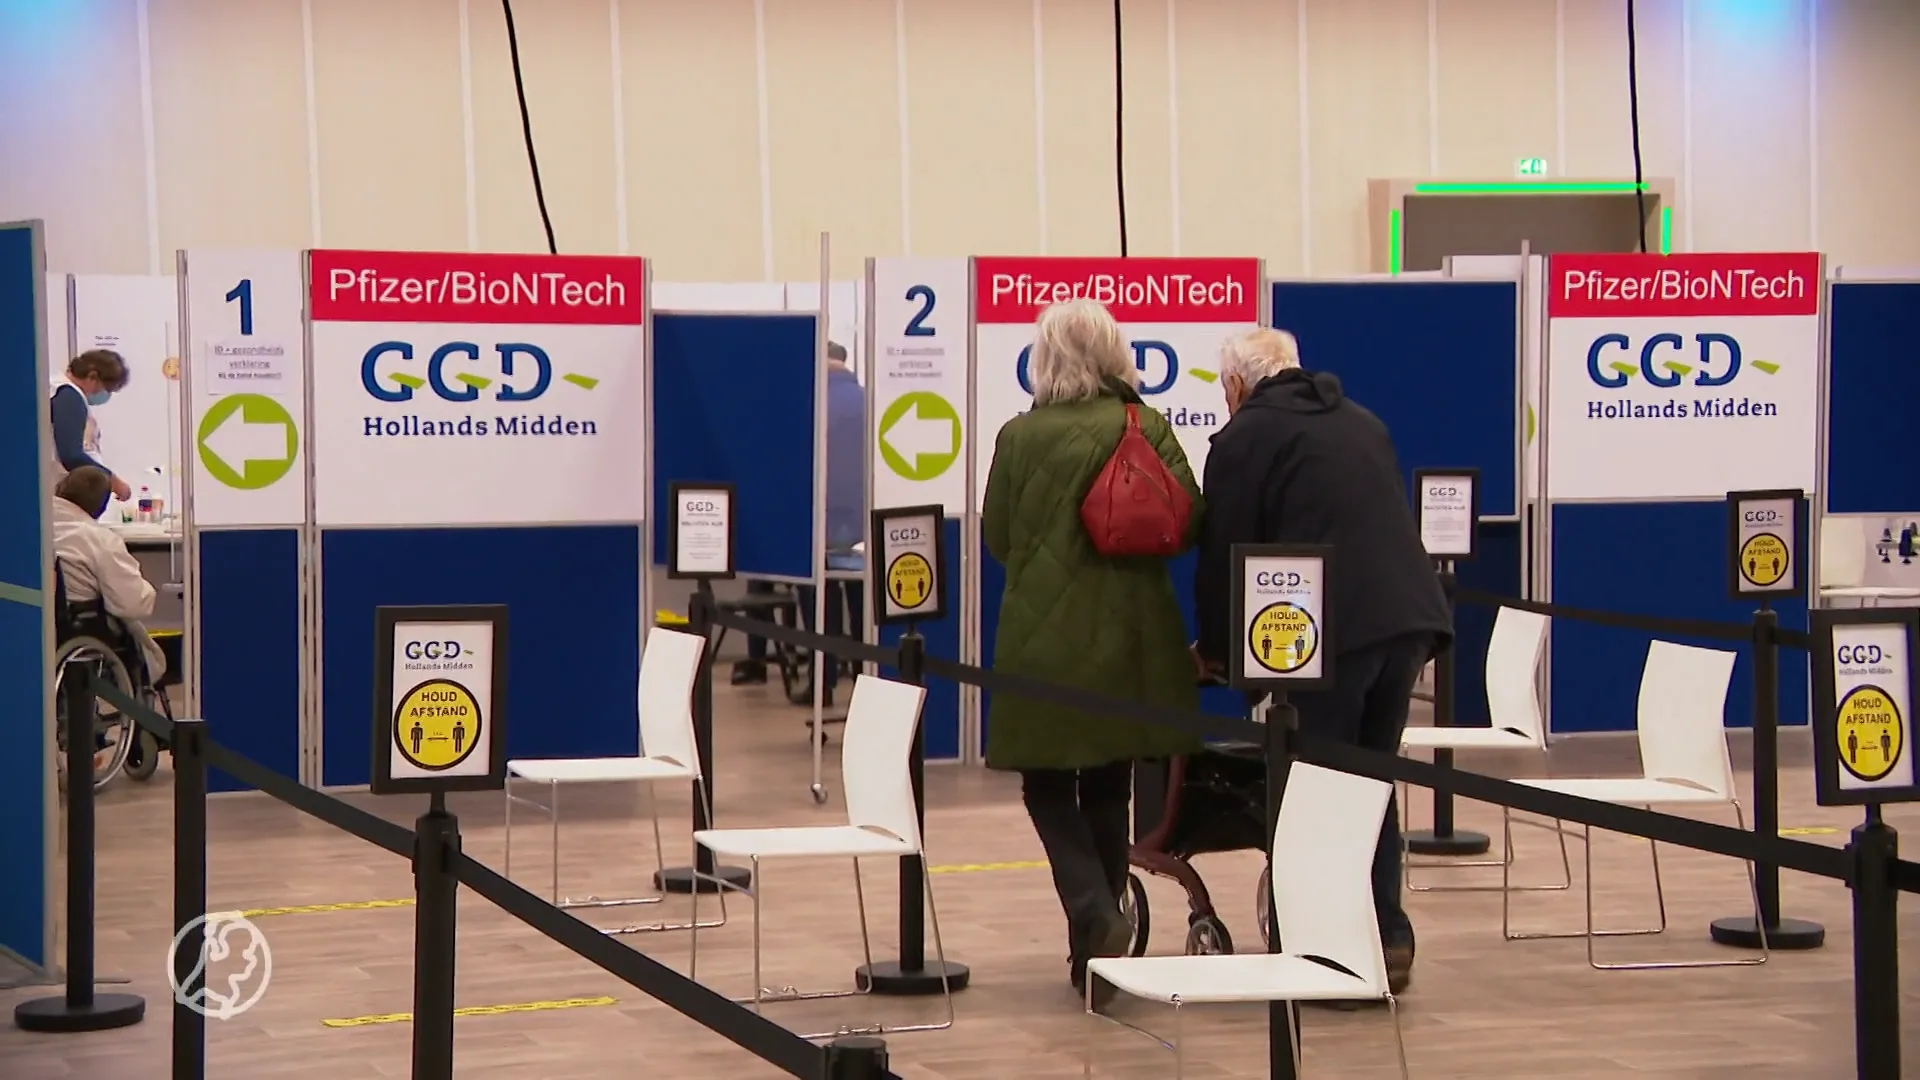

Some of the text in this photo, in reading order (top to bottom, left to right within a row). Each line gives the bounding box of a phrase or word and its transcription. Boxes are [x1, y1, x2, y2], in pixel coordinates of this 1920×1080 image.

[329, 268, 626, 306] Pfizer/BioNTech
[992, 273, 1244, 306] Pfizer/BioNTech
[1564, 269, 1805, 301] Pfizer/BioNTech
[225, 278, 253, 336] 1
[904, 284, 936, 336] 2
[1587, 333, 1742, 388] GGD
[361, 341, 552, 402] GGD
[1164, 407, 1217, 427] dden
[1588, 397, 1777, 419] Hollands Midden
[364, 415, 597, 436] Hollands Midden
[1257, 571, 1301, 586] GGD
[1270, 611, 1299, 620] HOUD
[1261, 623, 1307, 632] AFSTAND
[405, 641, 461, 660] GGD
[1837, 645, 1882, 664] GGD
[421, 691, 457, 702] HOUD
[1853, 697, 1882, 709] HOUD
[410, 705, 467, 717] AFSTAND
[1845, 713, 1892, 725] AFSTAND
